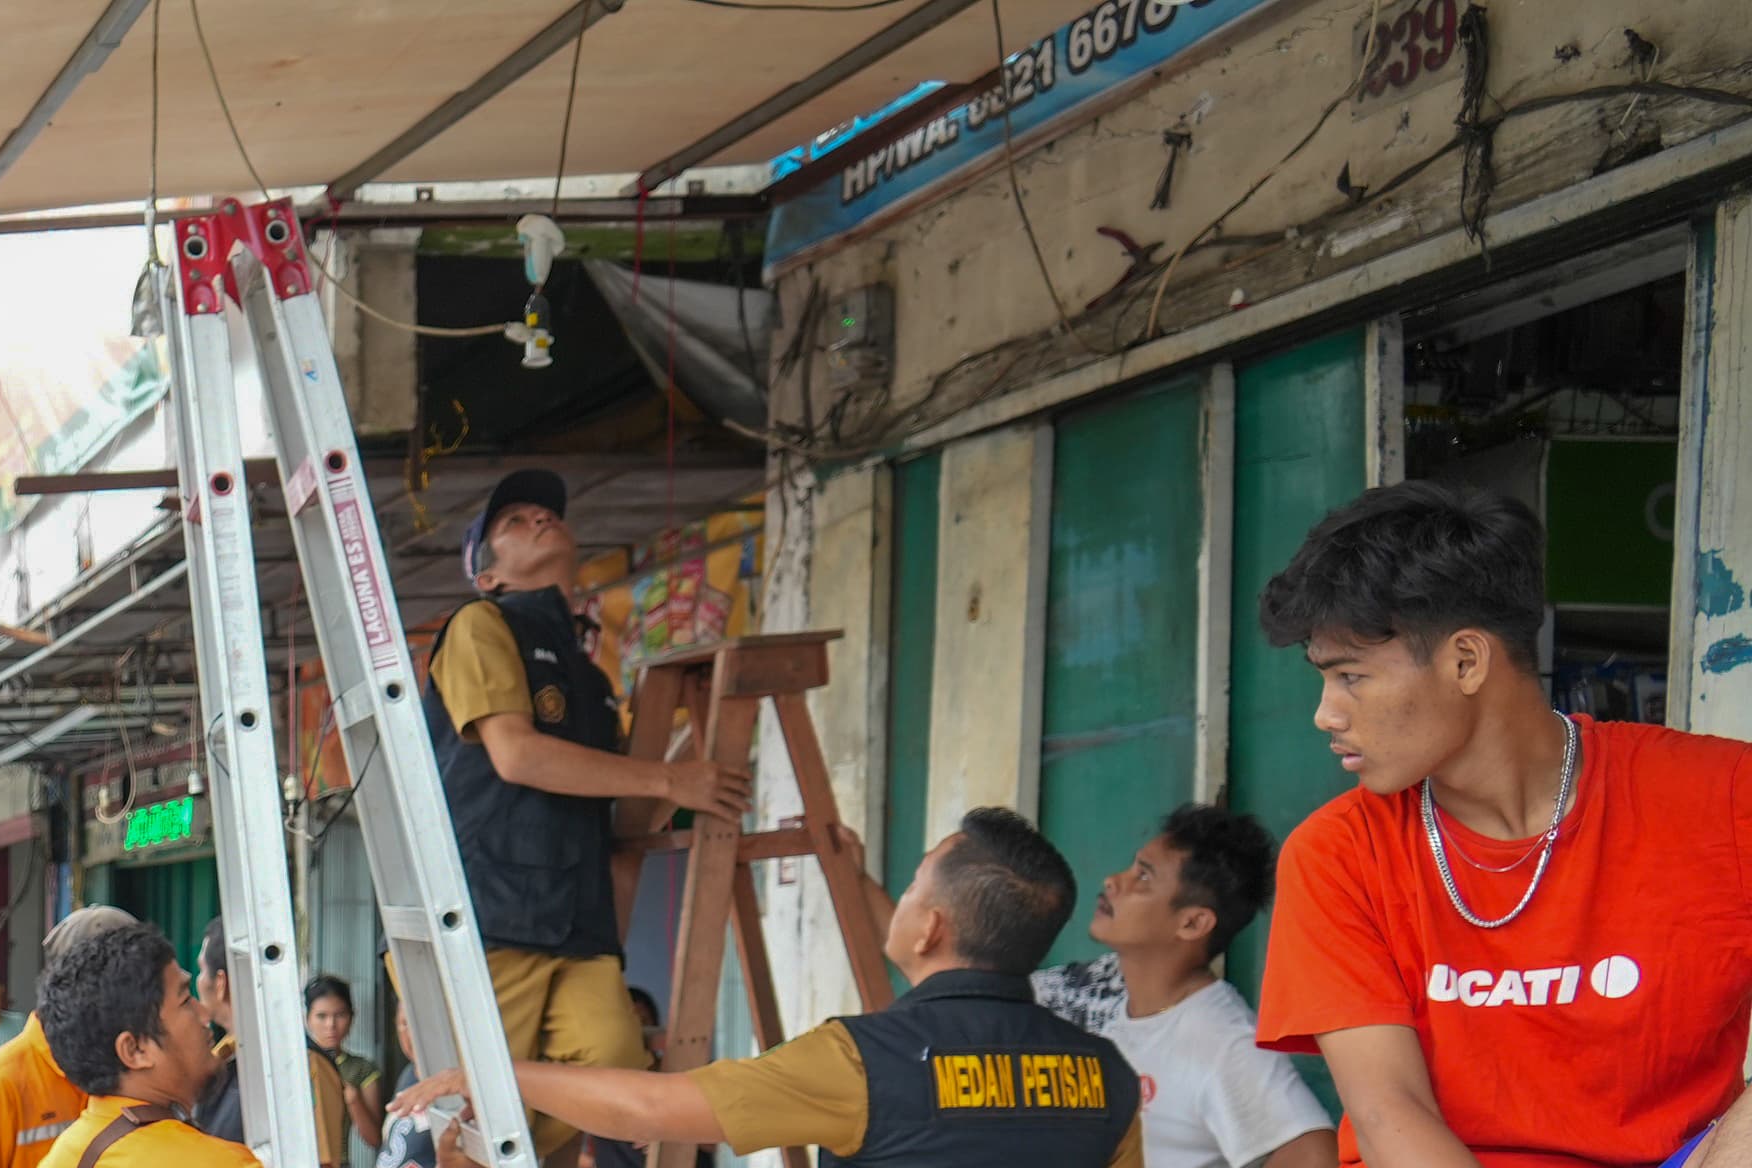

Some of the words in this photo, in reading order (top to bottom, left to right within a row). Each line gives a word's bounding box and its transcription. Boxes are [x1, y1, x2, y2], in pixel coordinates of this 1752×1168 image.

[1426, 963, 1581, 1008] UCATI
[933, 1054, 1016, 1108] MEDAN
[1020, 1054, 1105, 1108] PETISAH
